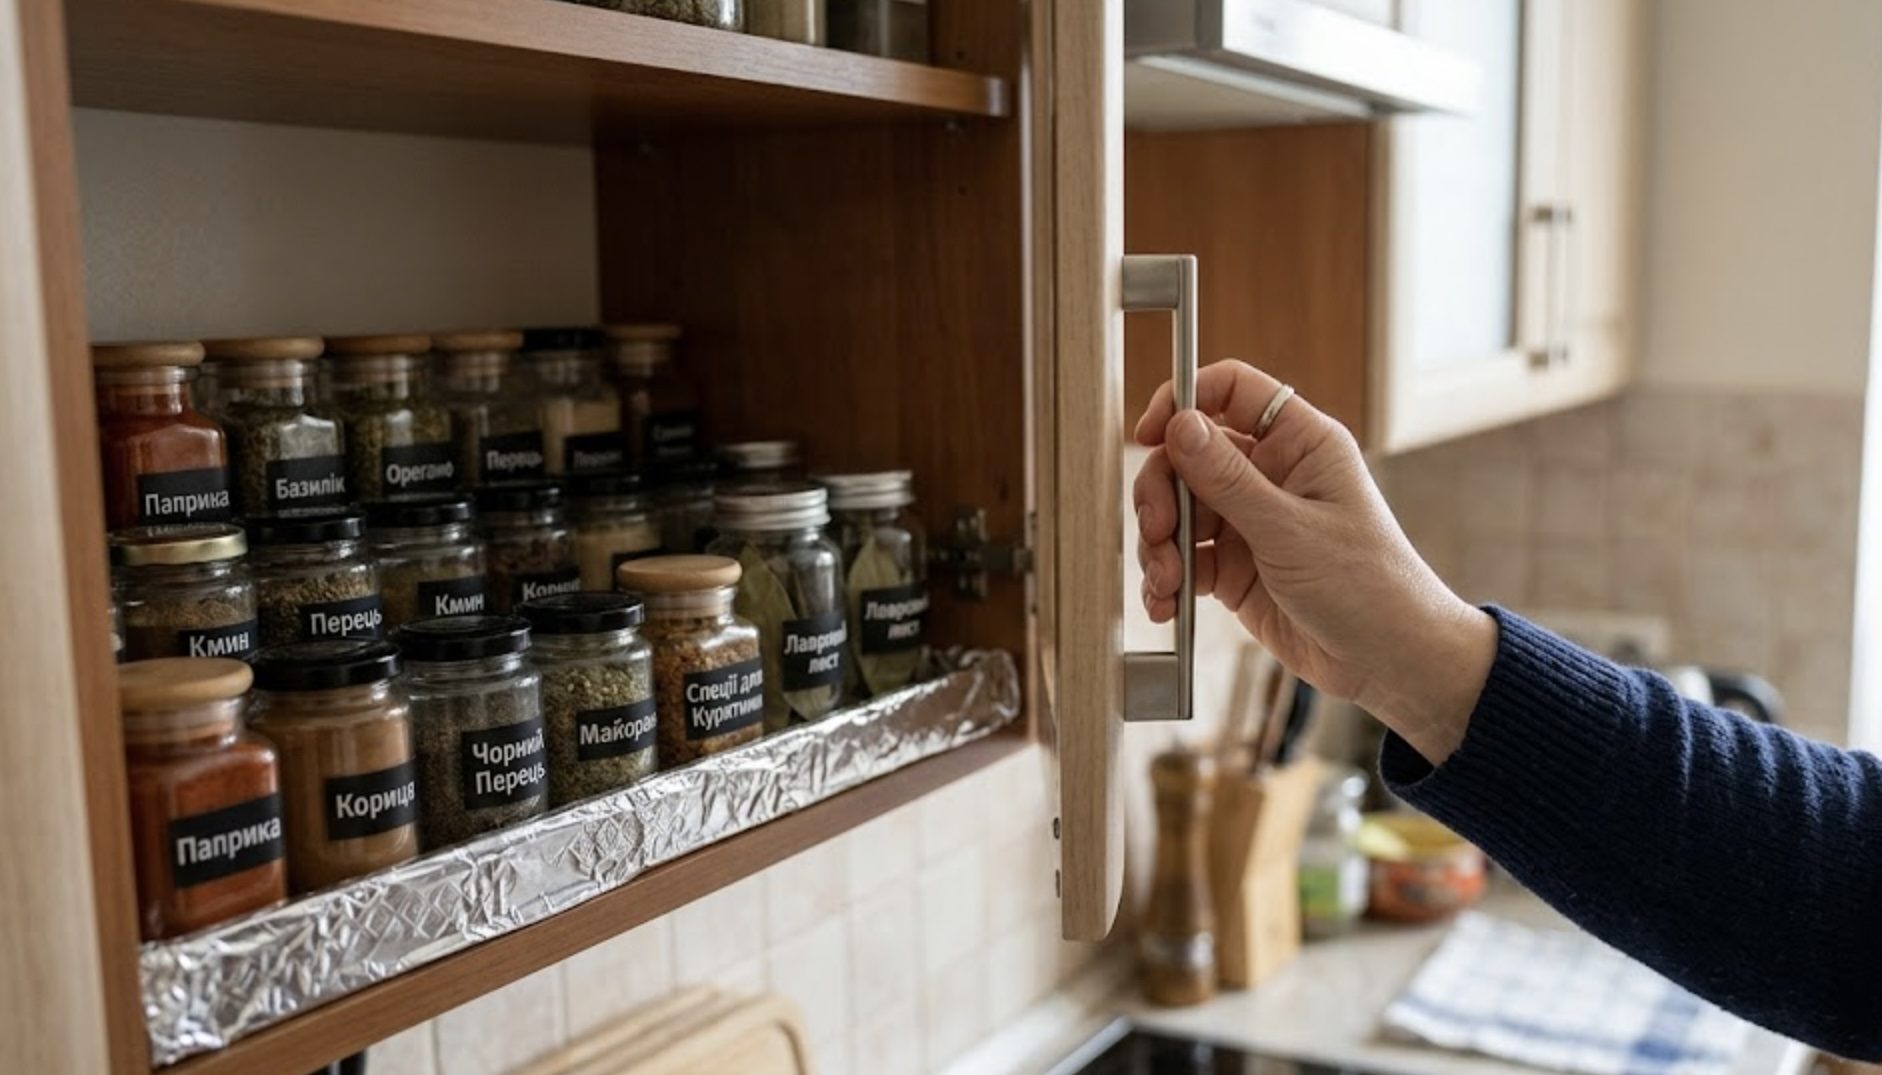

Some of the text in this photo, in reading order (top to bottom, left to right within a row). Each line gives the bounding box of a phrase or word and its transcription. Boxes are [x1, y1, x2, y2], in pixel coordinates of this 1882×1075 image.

[276, 475, 347, 500] Базилік
[145, 488, 230, 518] Паприка
[436, 593, 485, 616] Кмин
[311, 609, 383, 637] Перець
[189, 631, 250, 658] Кмин
[473, 728, 545, 767] Чорний
[475, 762, 545, 795] Перець
[176, 816, 281, 866] Паприка
